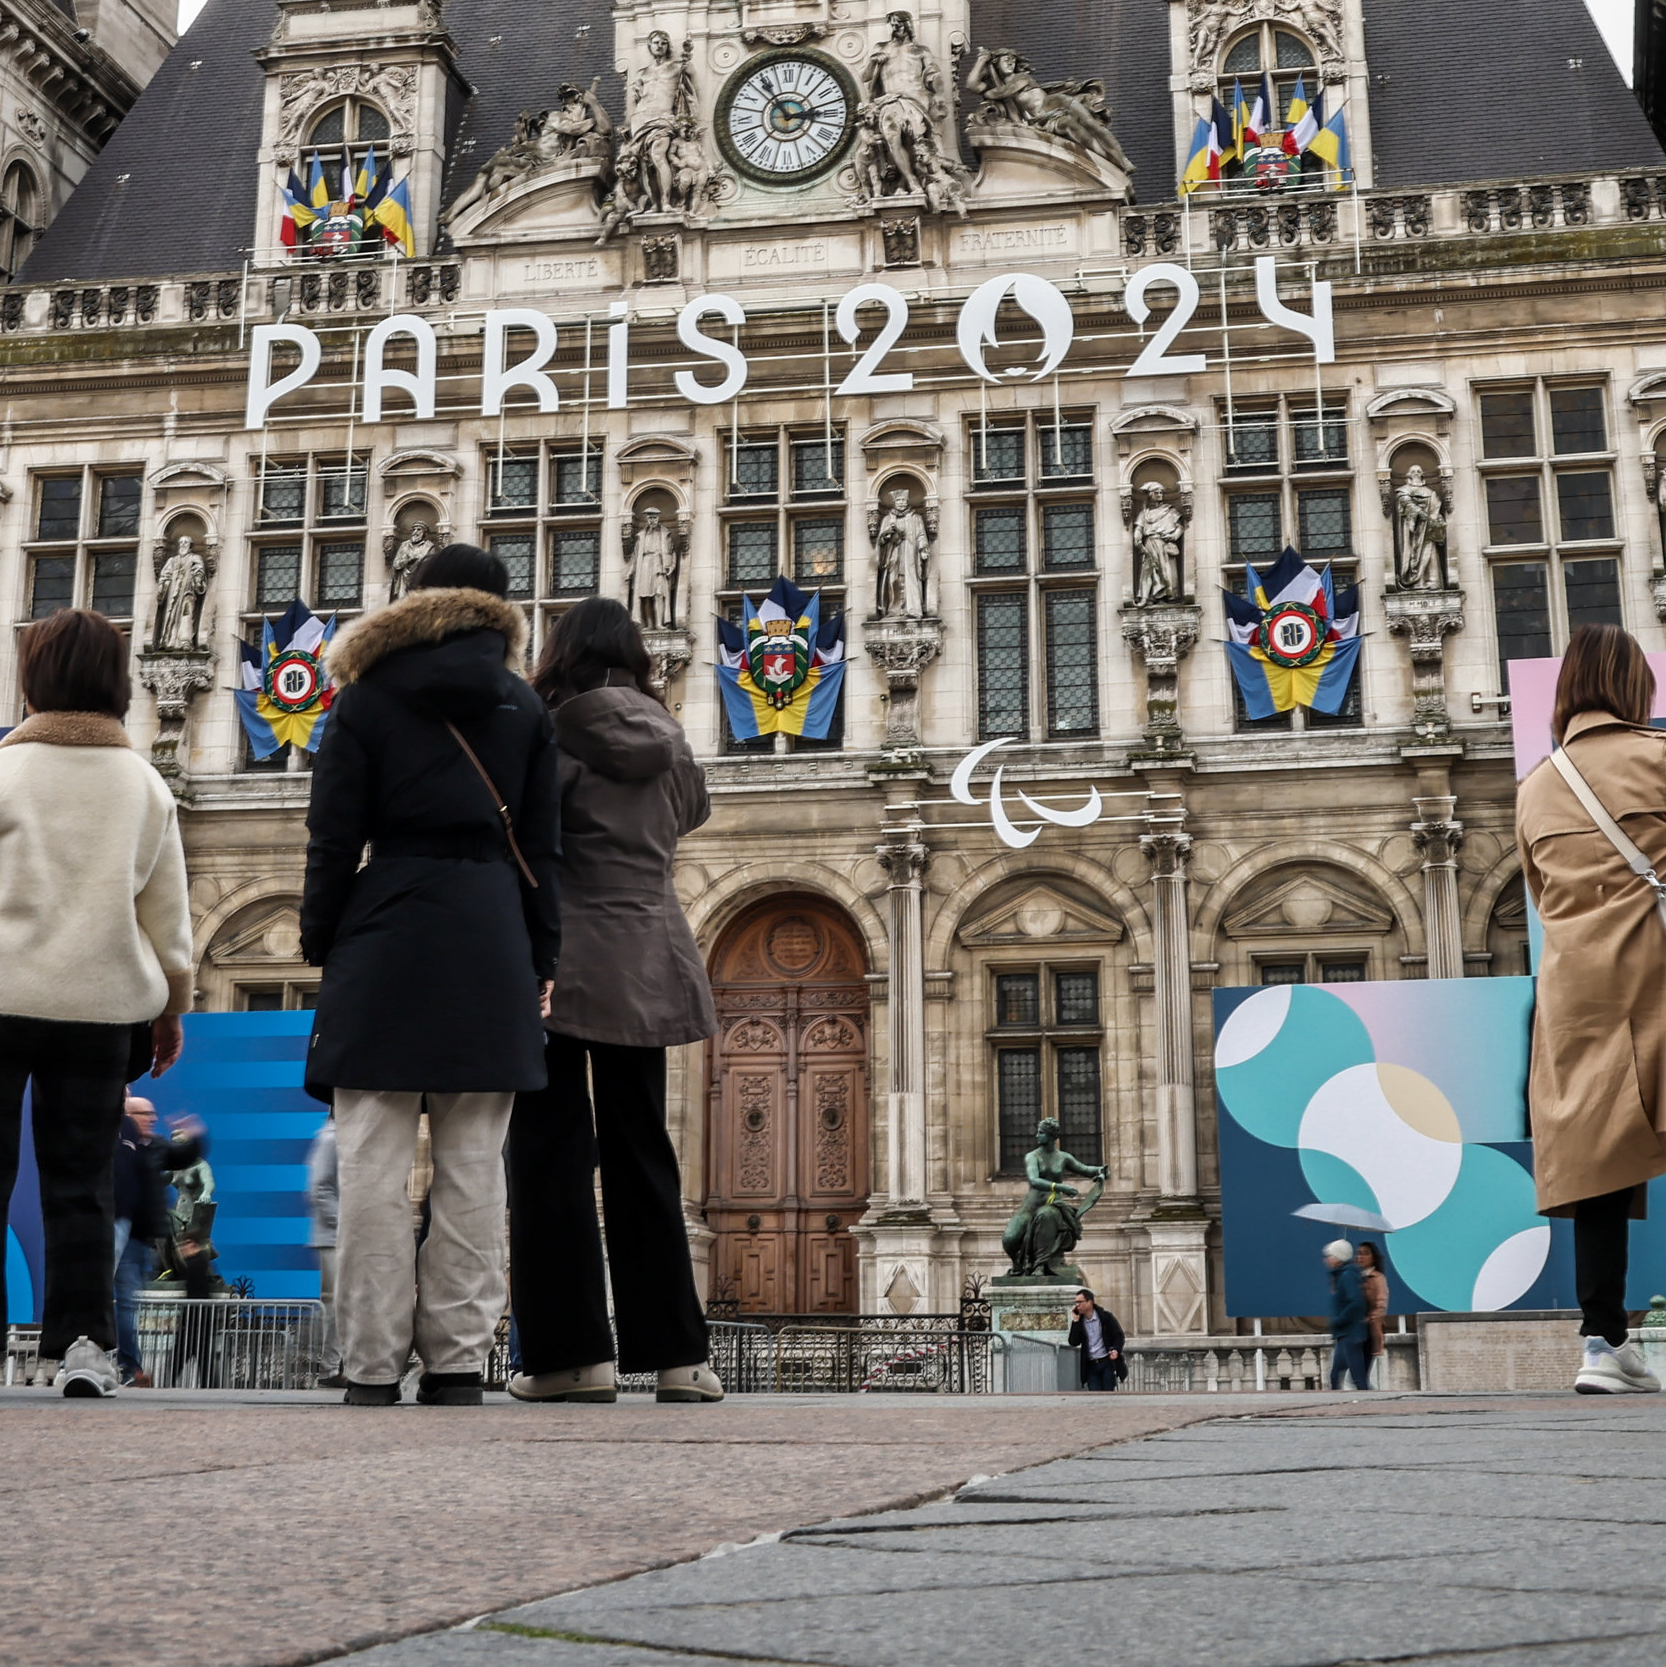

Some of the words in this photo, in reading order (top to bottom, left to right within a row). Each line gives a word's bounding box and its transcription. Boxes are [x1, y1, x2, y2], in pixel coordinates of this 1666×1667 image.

[783, 69, 794, 84] XII
[804, 73, 814, 86] I
[743, 94, 758, 104] X
[818, 87, 833, 99] II
[823, 109, 838, 118] III
[783, 150, 793, 165] VI
[805, 144, 816, 158] V
[959, 224, 1068, 251] FRATERNITÉ
[524, 257, 598, 281] LIBERTÉ
[835, 256, 1336, 395] 2024
[1280, 622, 1305, 647] RF
[284, 670, 306, 693] RF
